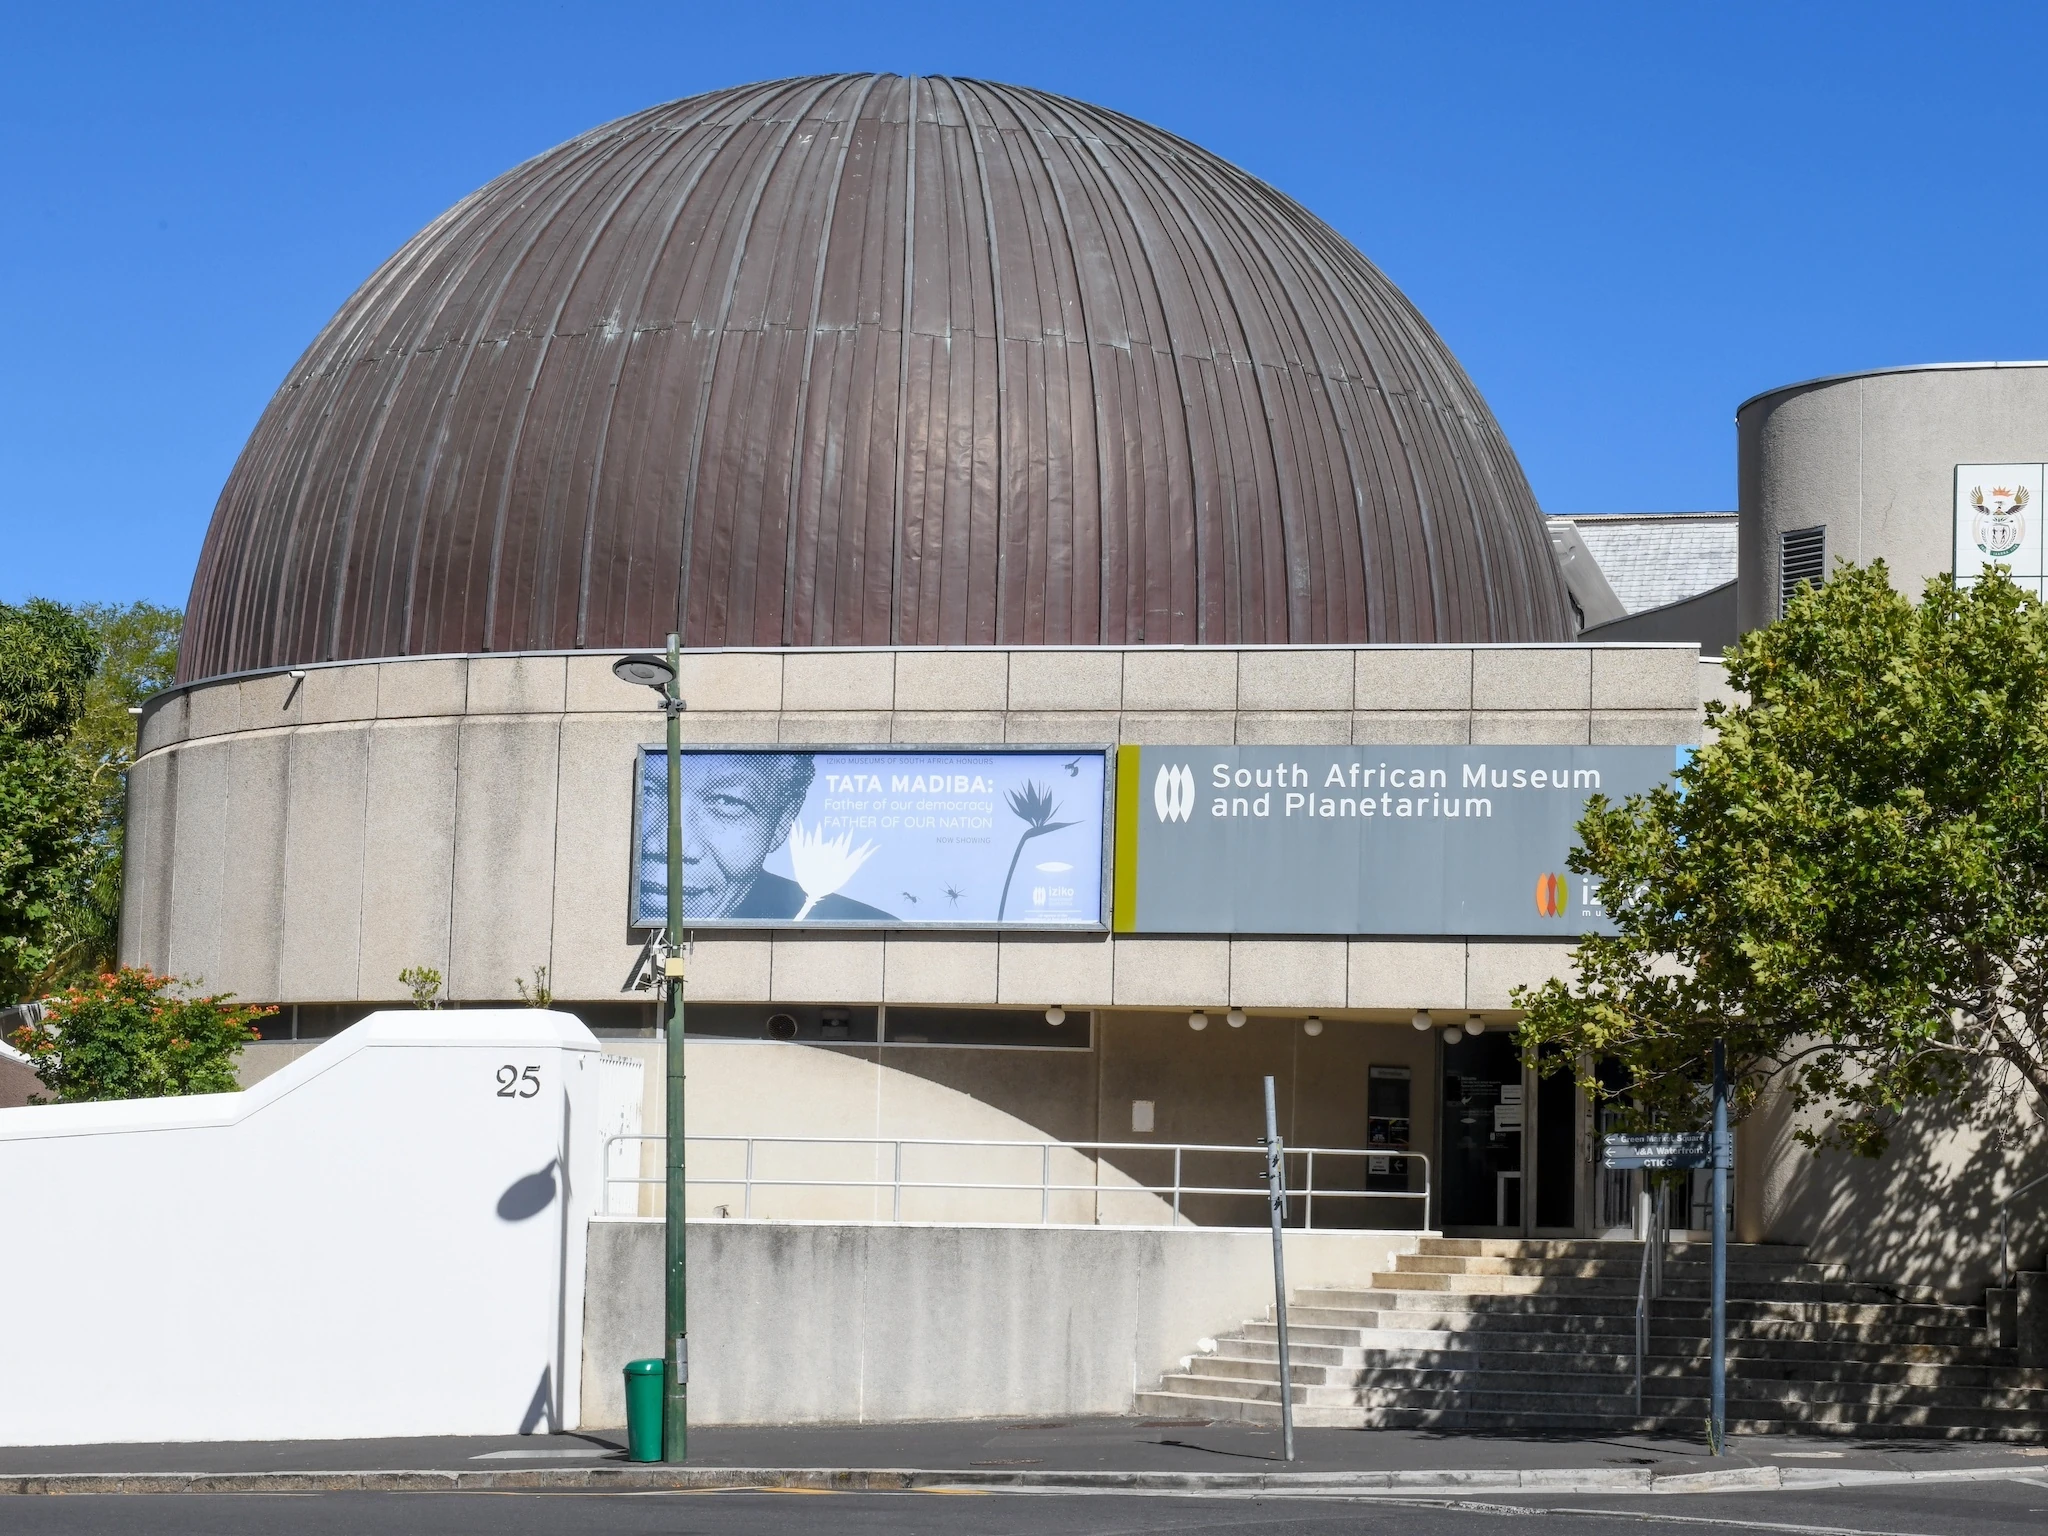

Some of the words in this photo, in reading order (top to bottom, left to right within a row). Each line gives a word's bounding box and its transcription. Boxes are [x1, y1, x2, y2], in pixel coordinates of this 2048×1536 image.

[826, 757, 846, 765] IZIKO
[848, 757, 885, 765] MUSEUMS
[887, 757, 898, 765] OF
[899, 757, 925, 765] SOUTH
[927, 757, 954, 765] AFRICA
[956, 757, 994, 765] HONOURS
[1211, 763, 1309, 788] South
[1324, 763, 1447, 788] African
[1462, 763, 1601, 788] Museum
[825, 774, 883, 793] TATA
[891, 774, 994, 793] MADIBA:
[824, 798, 869, 811] Father
[873, 798, 888, 811] of
[890, 800, 913, 811] our
[916, 798, 993, 813] democracy
[1211, 792, 1270, 817] and
[1285, 792, 1492, 817] Planetarium
[824, 816, 877, 829] FATHER
[881, 816, 900, 828] OF
[904, 816, 936, 828] OUR
[939, 816, 993, 828] NATION
[1049, 887, 1074, 896] iziko
[496, 1064, 541, 1099] 25
[1646, 1135, 1674, 1143] Market
[1677, 1135, 1704, 1144] Square
[1634, 1147, 1653, 1156] V&A
[1656, 1147, 1703, 1155] Waterfront
[1644, 1159, 1673, 1167] CTICC
